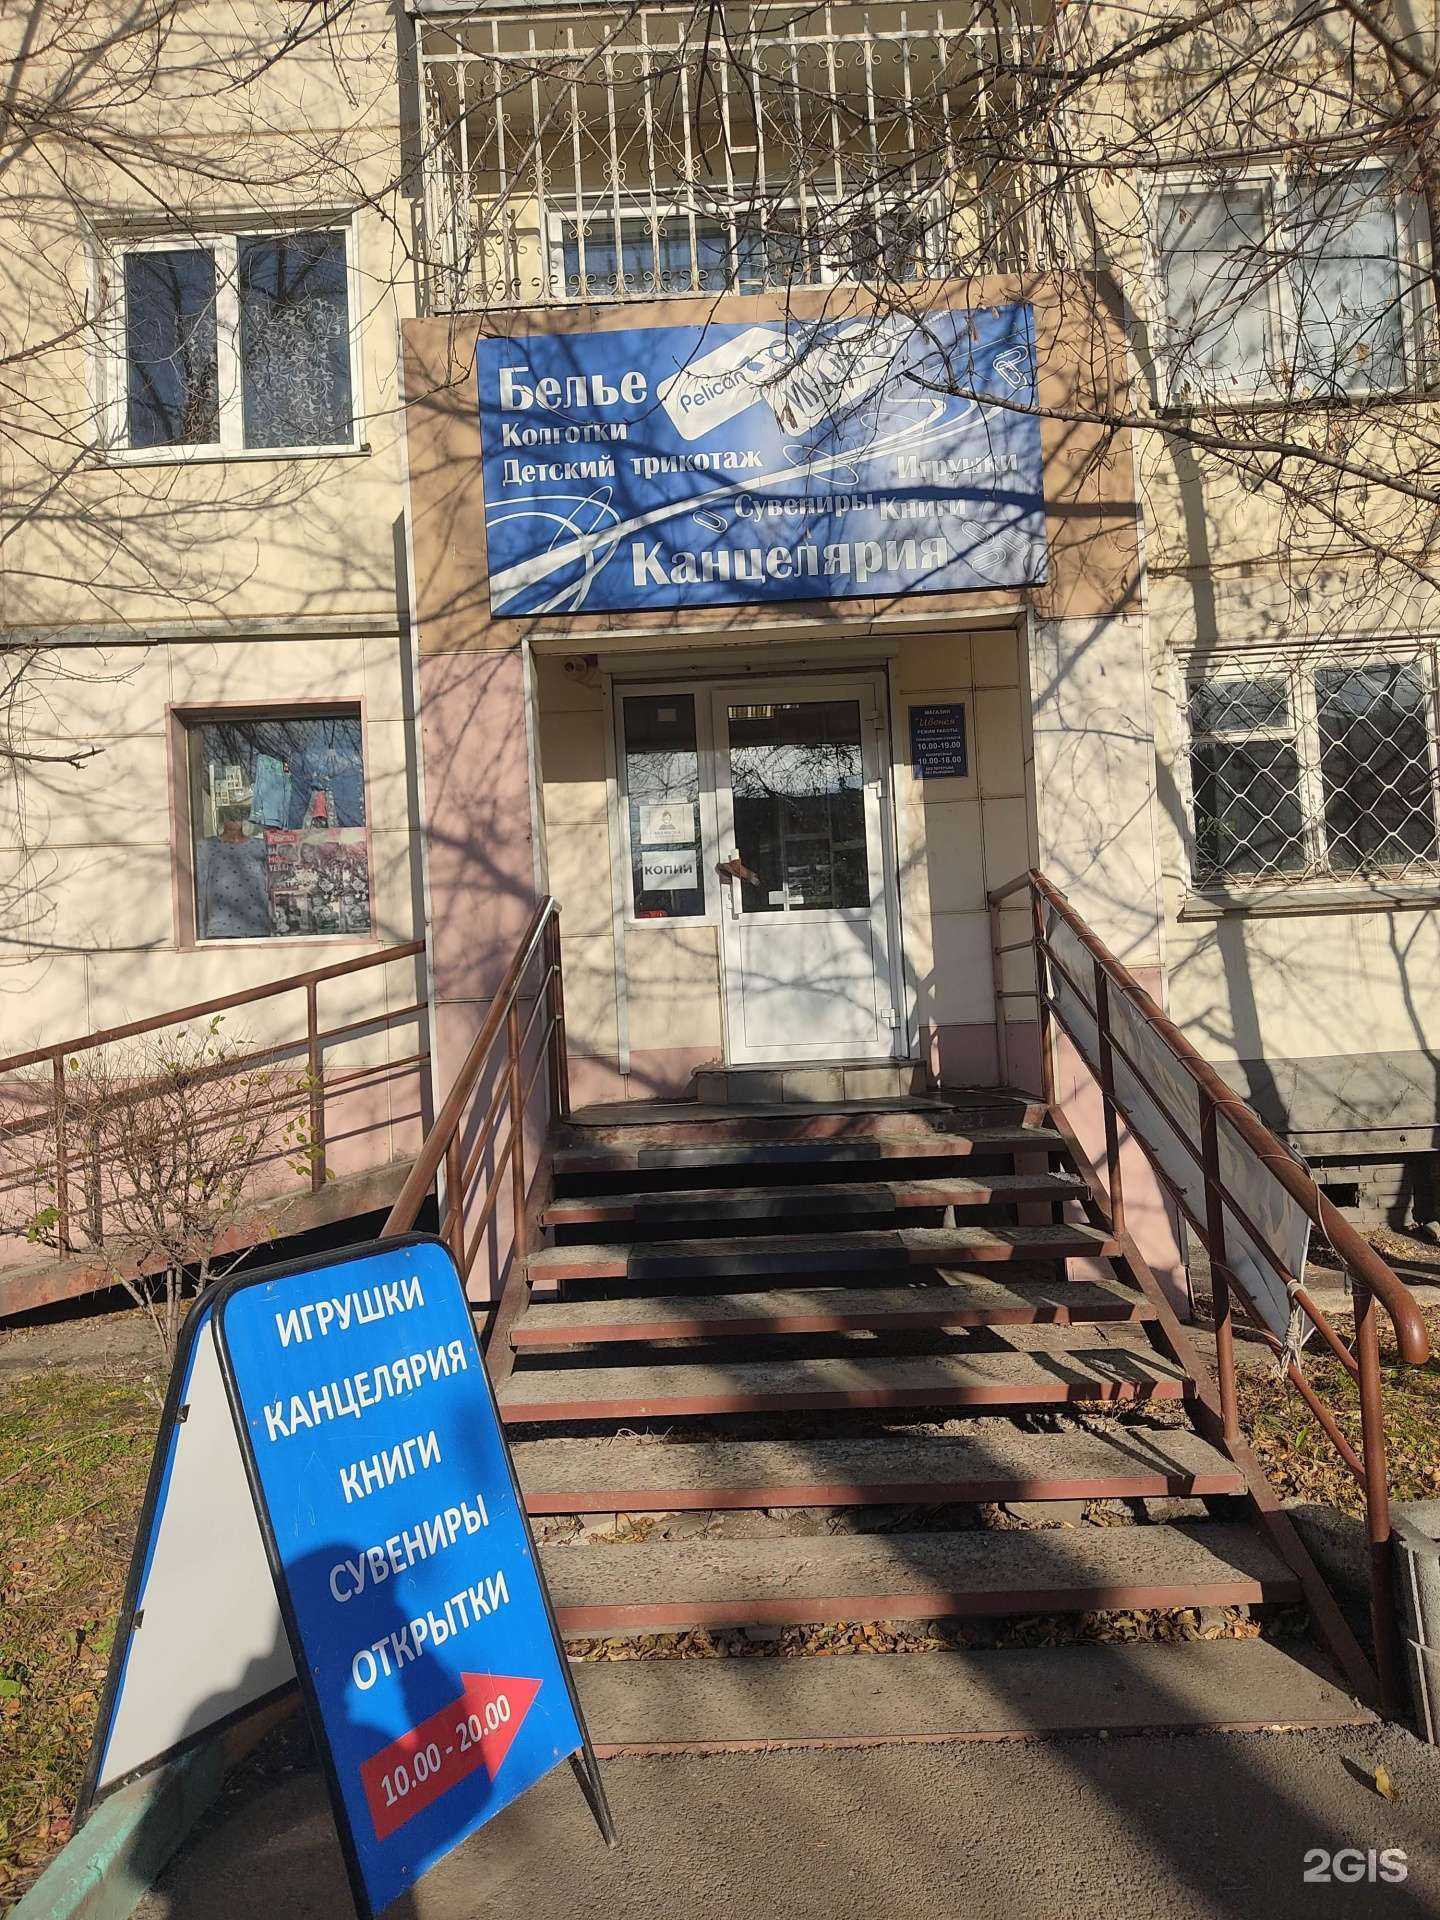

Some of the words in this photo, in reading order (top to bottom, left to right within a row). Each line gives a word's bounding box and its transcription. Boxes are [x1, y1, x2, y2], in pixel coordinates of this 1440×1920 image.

[499, 367, 648, 412] Белье
[680, 370, 748, 413] Pelican
[501, 423, 628, 447] Колготки
[502, 455, 616, 486] Детский
[630, 450, 764, 480] трикотаж
[897, 453, 1018, 482] Игрушки
[734, 493, 873, 522] Сувениры
[879, 497, 966, 520] Книги
[631, 536, 947, 587] Канцелярия
[918, 741, 961, 751] 10.00-19.00
[275, 1275, 425, 1348] ИГРУШКИ
[263, 1339, 468, 1442] КАНЦЕЛЯРИЯ
[339, 1430, 442, 1504] КНИГИ
[329, 1494, 490, 1603] СУВЕНИРЫ
[352, 1570, 510, 1691] ОТКРЫТКИ
[381, 1743, 441, 1807] 10.00
[456, 1694, 511, 1752] 20.00
